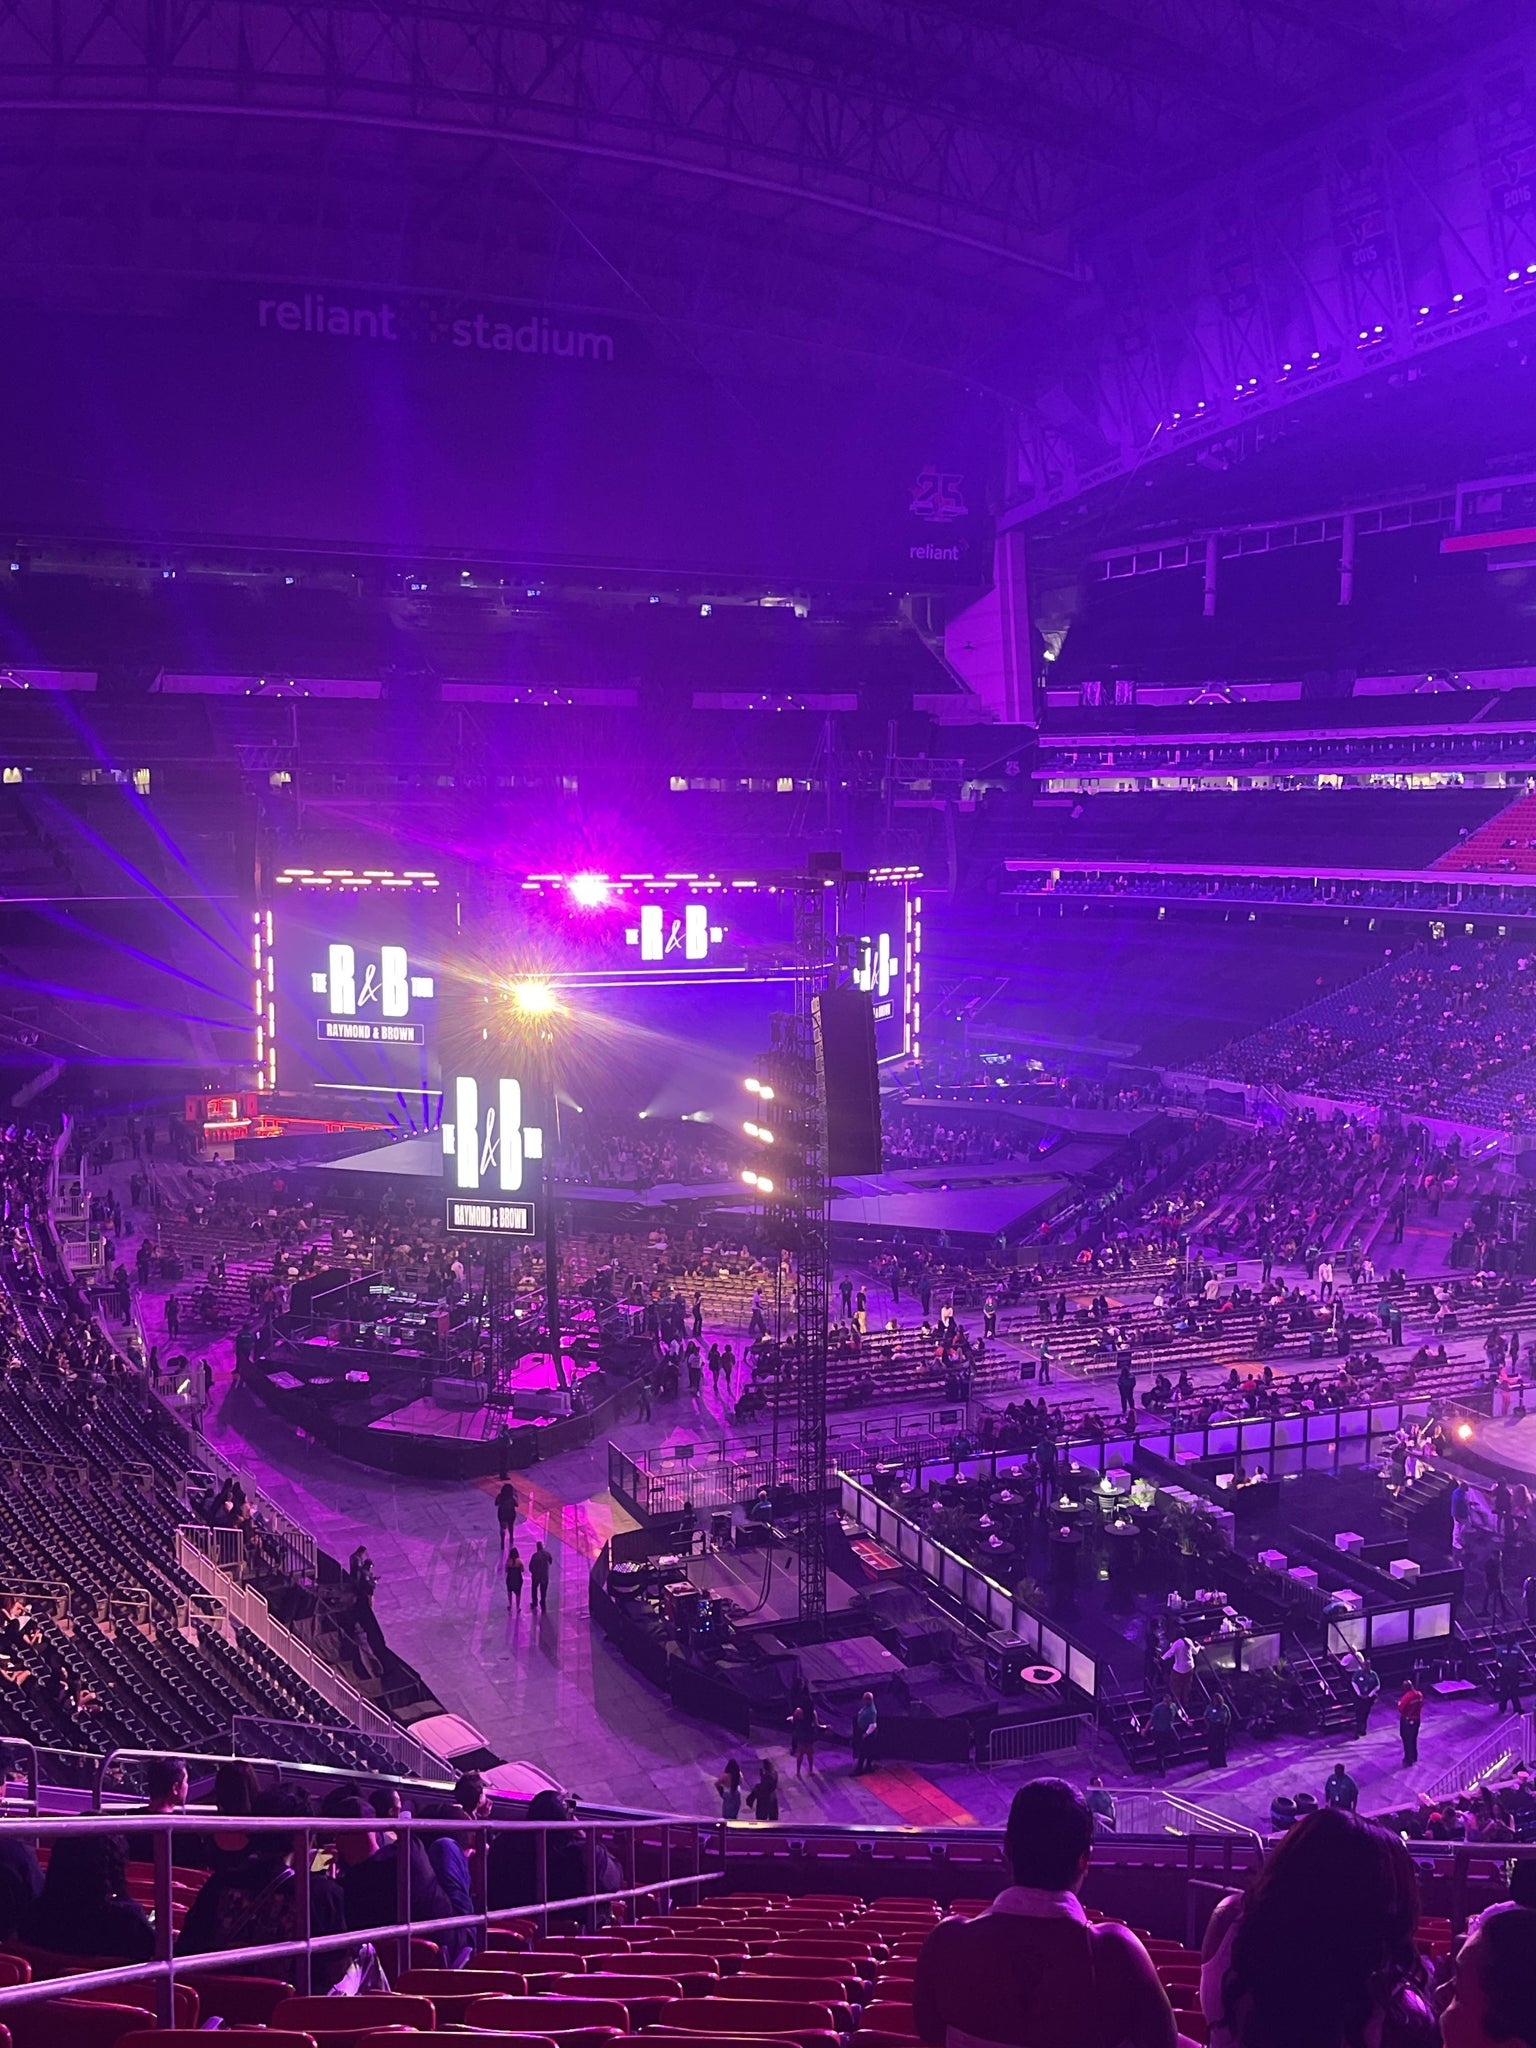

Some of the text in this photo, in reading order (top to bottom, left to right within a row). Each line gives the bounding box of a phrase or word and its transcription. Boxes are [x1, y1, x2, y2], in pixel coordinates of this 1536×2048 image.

[1503, 184, 1532, 209] 2016
[257, 292, 615, 361] reliant stadium
[909, 543, 960, 561] reliant
[326, 1023, 415, 1041] RAYMOND & BROWN
[454, 1204, 528, 1230] RAYMOND & BROWN
